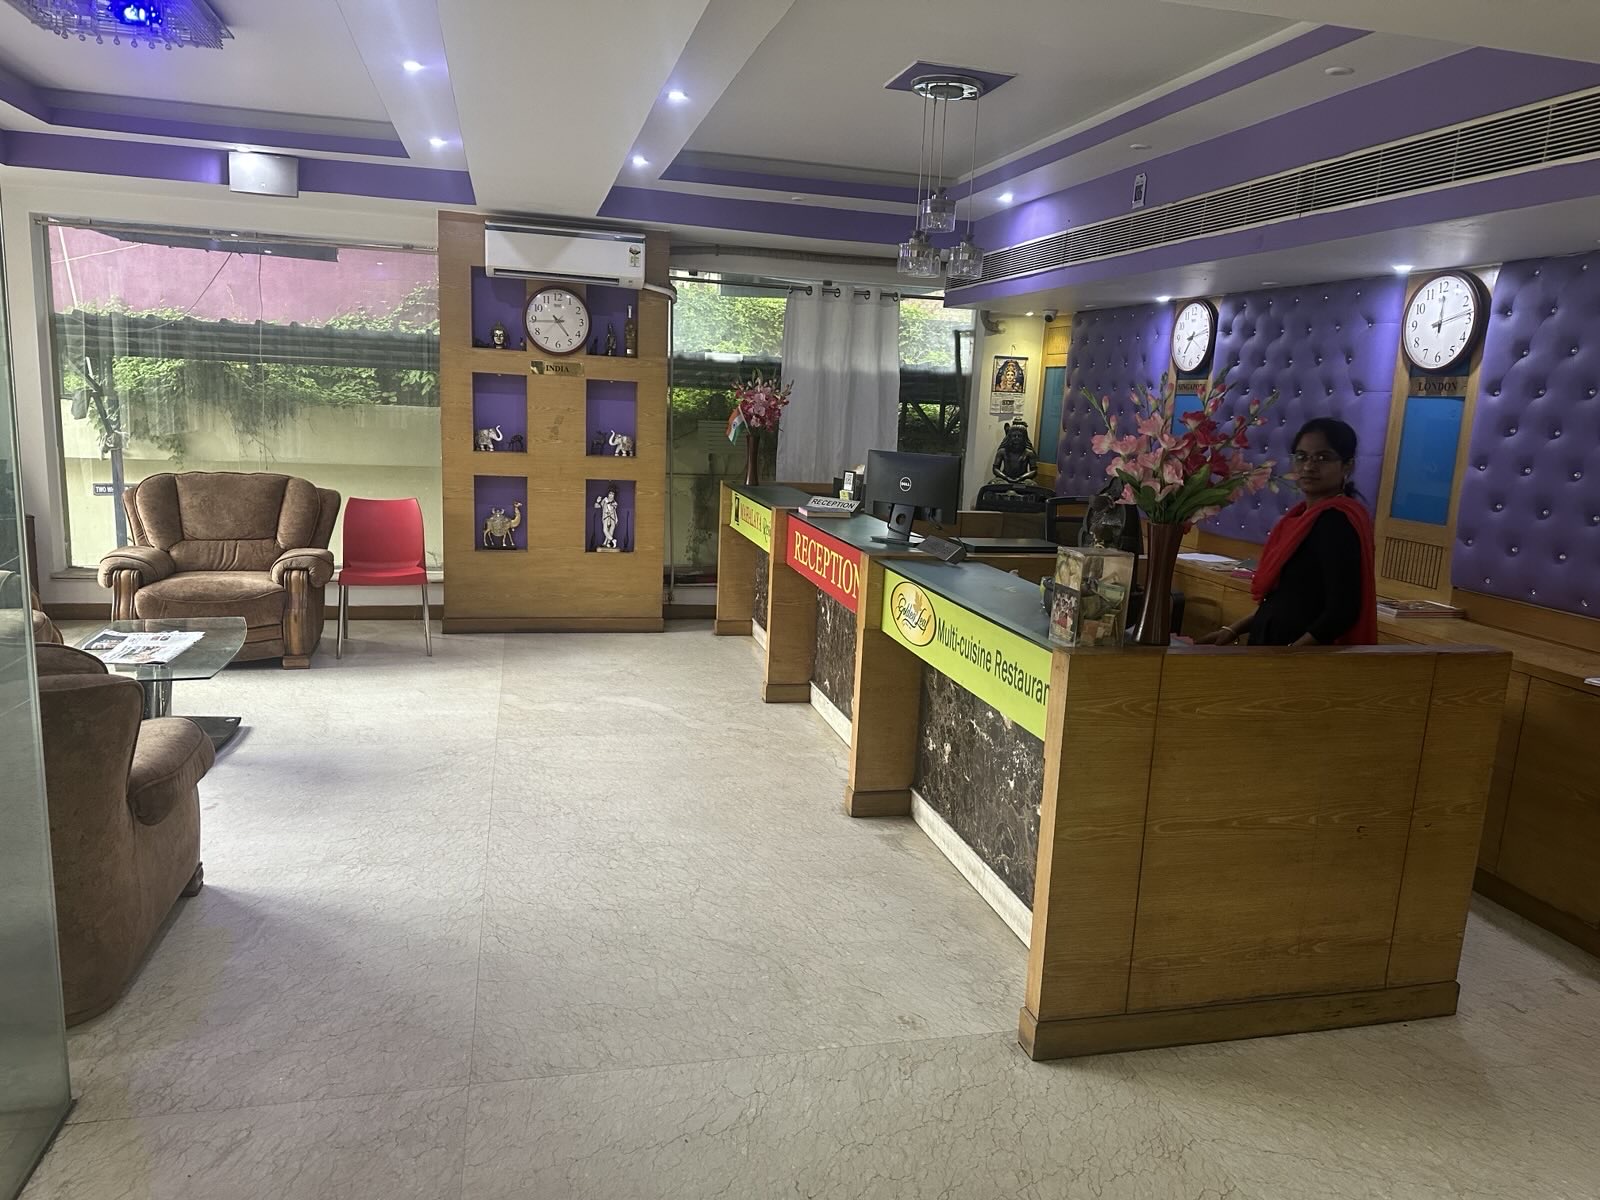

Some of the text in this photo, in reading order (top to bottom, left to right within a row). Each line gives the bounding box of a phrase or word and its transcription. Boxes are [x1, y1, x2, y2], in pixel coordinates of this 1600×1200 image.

[1439, 281, 1449, 293] 12
[543, 296, 550, 304] 11
[553, 293, 563, 301] 12
[1426, 289, 1435, 300] 11
[1463, 296, 1469, 307] 2
[534, 304, 543, 312] 10
[575, 307, 581, 315] 2
[1416, 303, 1426, 315] 10
[1465, 312, 1472, 325] 3
[1411, 320, 1418, 332] 9
[1413, 337, 1420, 348] 8
[1459, 332, 1466, 342] 4
[1422, 349, 1429, 360] 7
[1449, 346, 1455, 357] 5
[1434, 352, 1441, 363] 6
[546, 364, 569, 373] INDIA
[1418, 382, 1458, 391] LONDON
[811, 498, 856, 510] RECEPTION
[937, 617, 992, 673] Multi-cuisine
